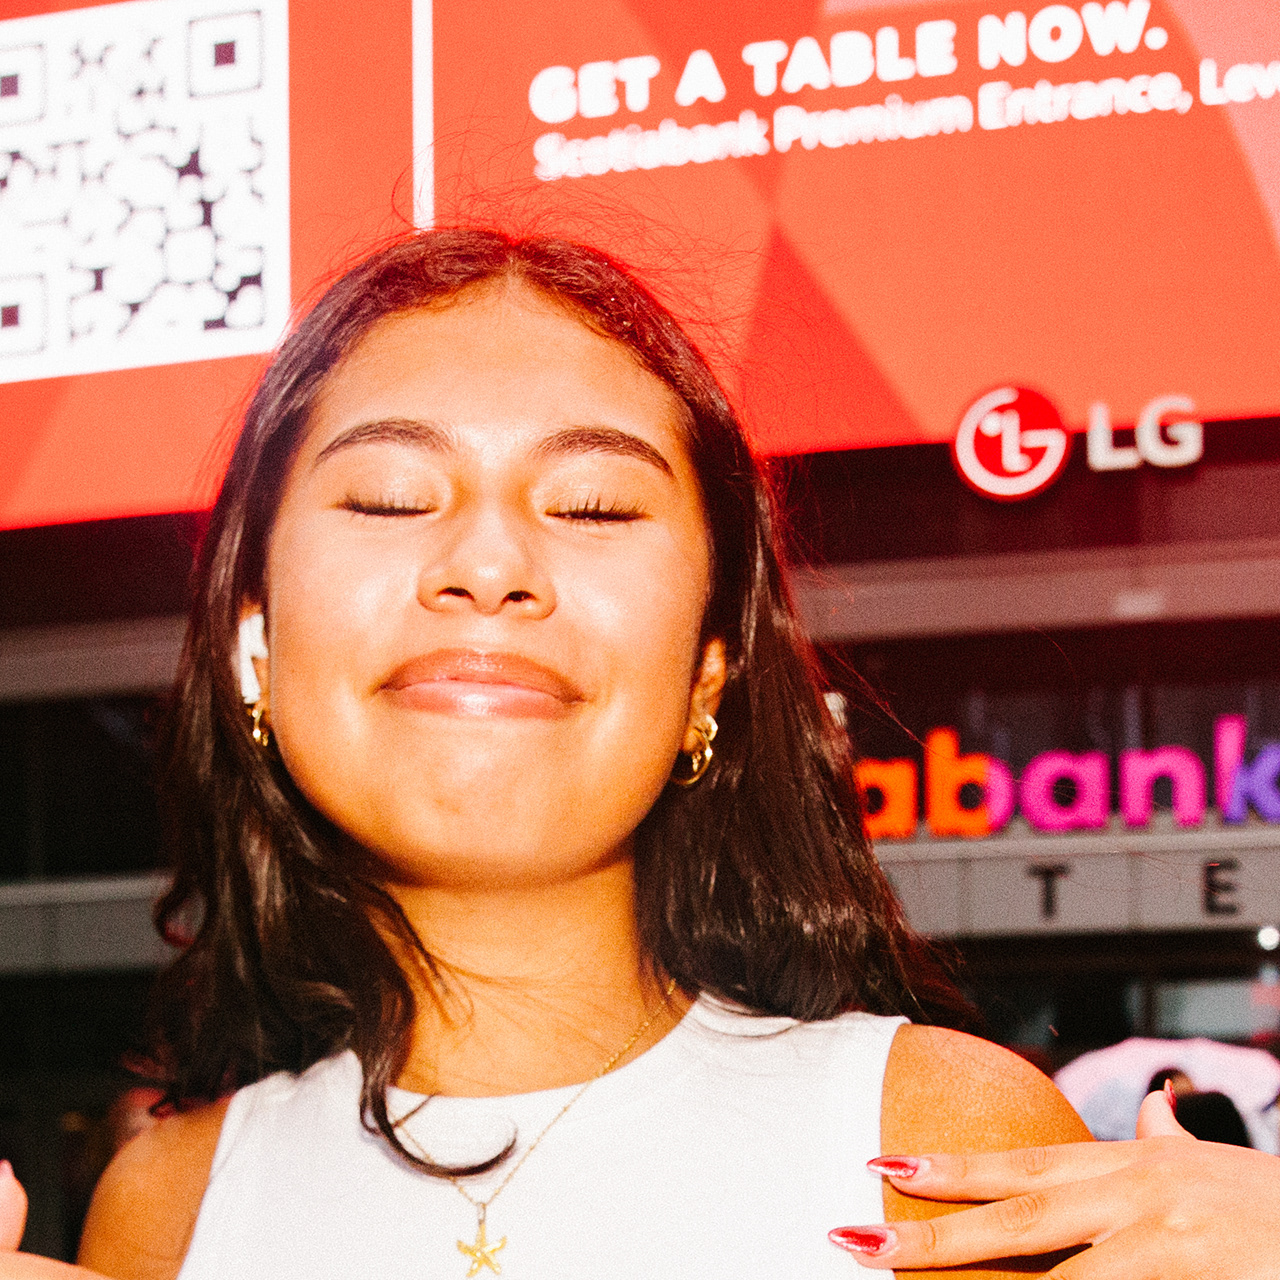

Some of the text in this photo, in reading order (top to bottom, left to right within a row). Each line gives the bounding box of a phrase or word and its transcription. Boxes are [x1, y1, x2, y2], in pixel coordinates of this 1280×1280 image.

[528, 0, 1169, 124] GET A TABLE NOW.
[772, 93, 974, 153] Premium
[977, 71, 1194, 131] Entrance,
[1086, 396, 1205, 472] LG
